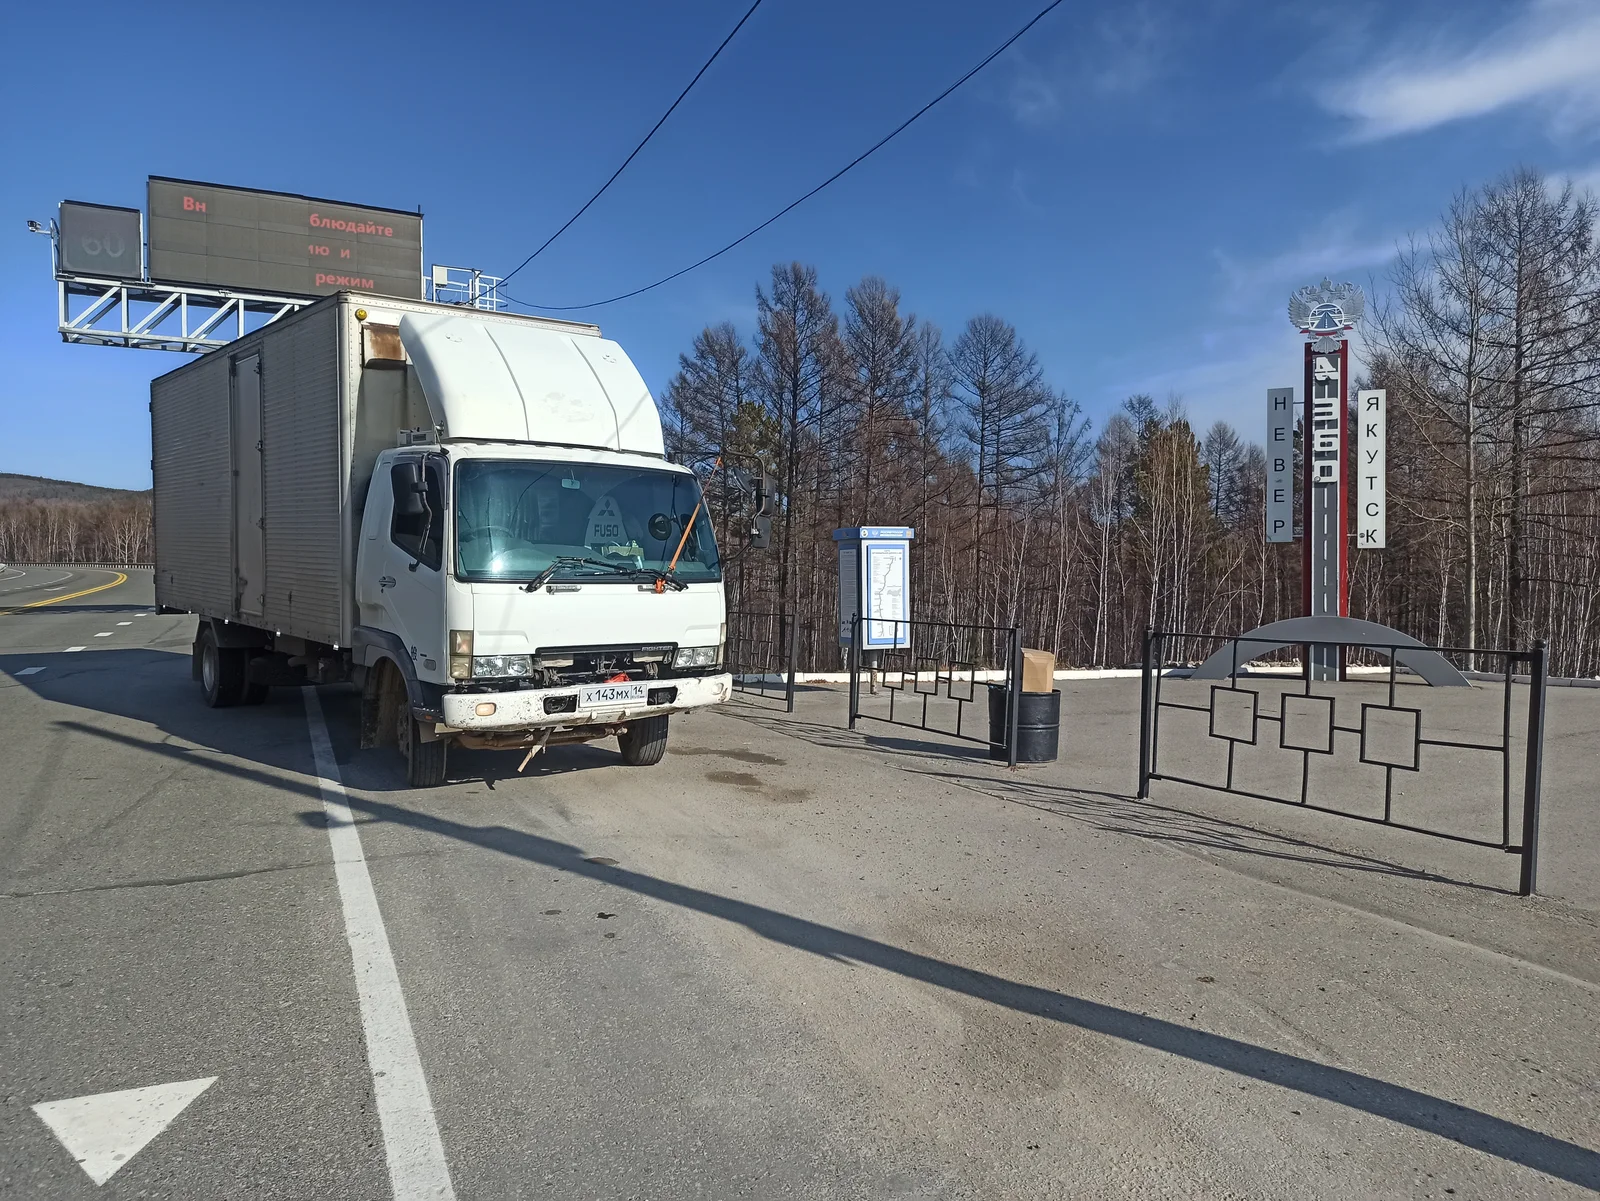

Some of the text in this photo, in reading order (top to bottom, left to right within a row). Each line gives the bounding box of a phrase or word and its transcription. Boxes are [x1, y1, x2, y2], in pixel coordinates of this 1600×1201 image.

[183, 196, 207, 212] Вн
[309, 213, 394, 237] блюдайте
[315, 273, 374, 289] режим
[1273, 396, 1286, 534] НЕВЕР
[1365, 396, 1380, 543] ЯКУТСК
[593, 524, 619, 537] FUSO
[633, 685, 643, 695] 14
